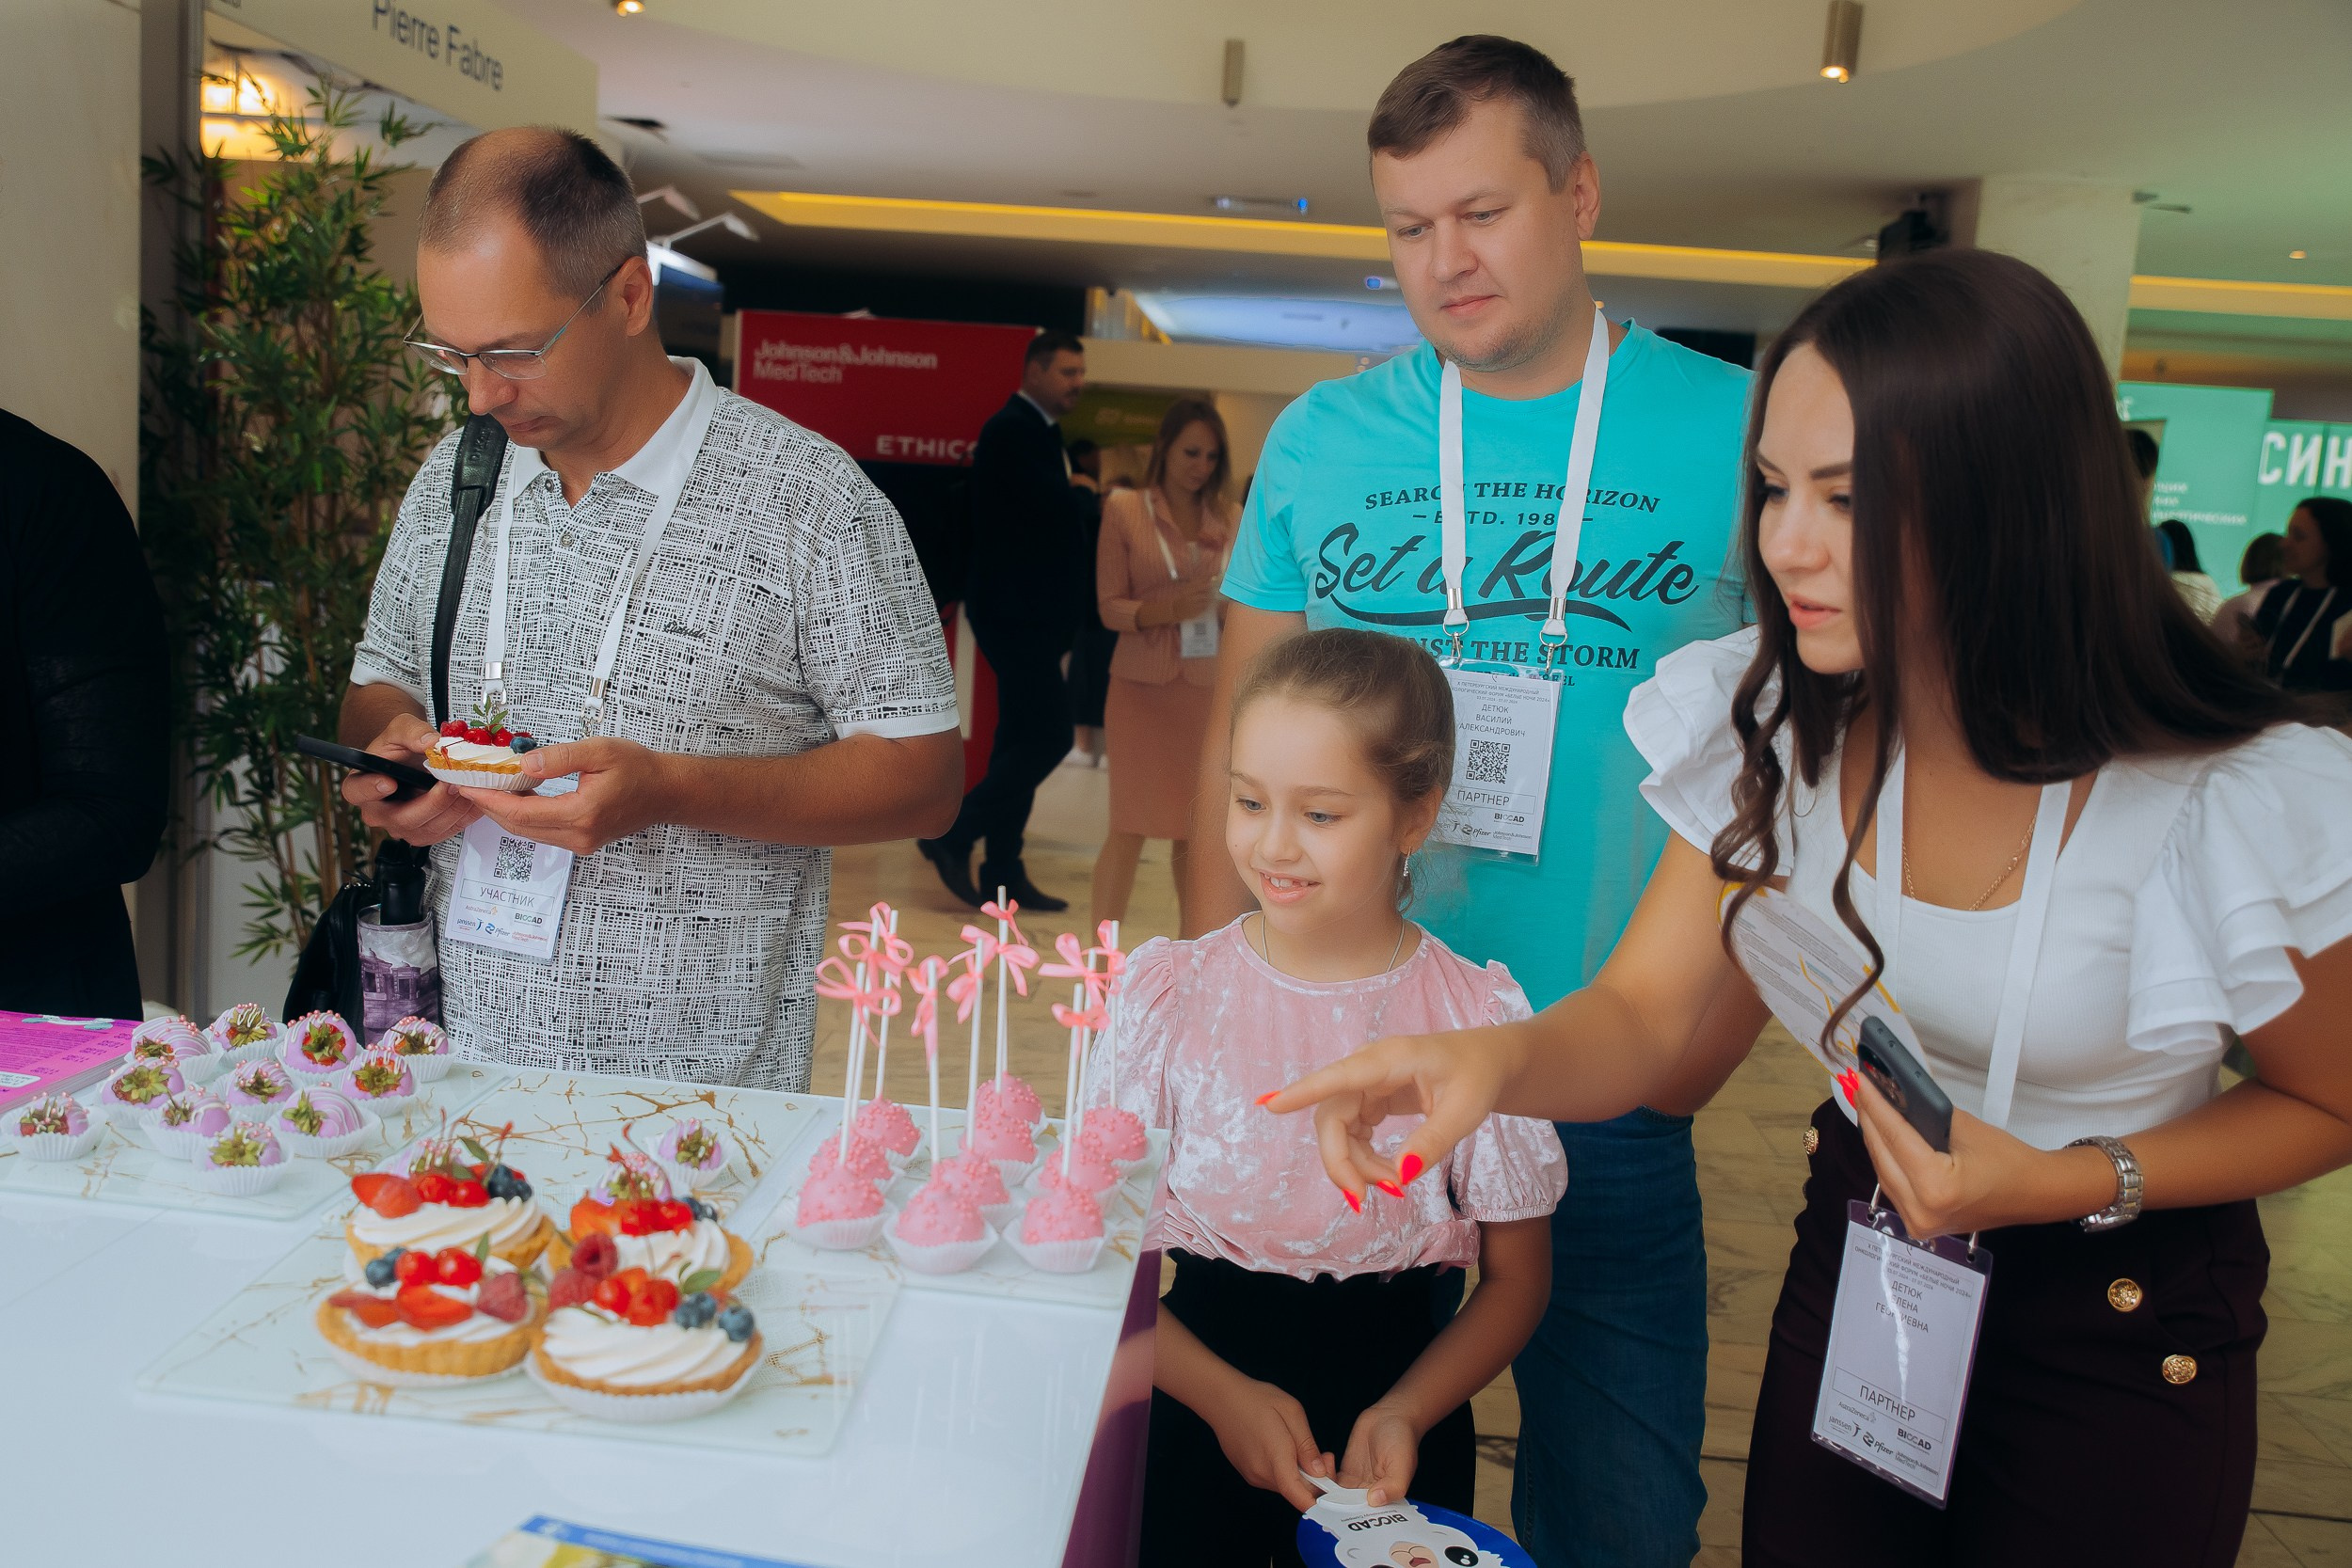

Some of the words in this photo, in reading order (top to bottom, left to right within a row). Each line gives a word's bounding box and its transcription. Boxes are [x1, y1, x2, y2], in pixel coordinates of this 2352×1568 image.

[373, 0, 440, 58] Pierre
[445, 24, 503, 91] Fabre
[754, 359, 842, 384] MedTech
[2257, 430, 2352, 489] СИН
[1365, 483, 1466, 510] SEARC
[1474, 483, 1527, 498] THE
[1435, 511, 1504, 525] ETD.
[1518, 513, 1558, 526] 198
[1316, 522, 1426, 599] Set
[1478, 531, 1699, 605] Route
[1471, 641, 1529, 663] THE
[1538, 643, 1640, 670] STORM
[1476, 713, 1512, 724] ВАСИЛИЙ
[1482, 704, 1509, 713] ДЕТЮК
[1459, 722, 1526, 736] АЛЕКСАНДРОВИЧ
[1457, 790, 1510, 806] ПАРТНЕР
[480, 887, 534, 908] УЧАСТНИК
[1892, 1280, 1923, 1300] ДЕТЮК
[1838, 1402, 1869, 1421] AstraZeneca
[1860, 1385, 1915, 1421] ПАРТНЕР
